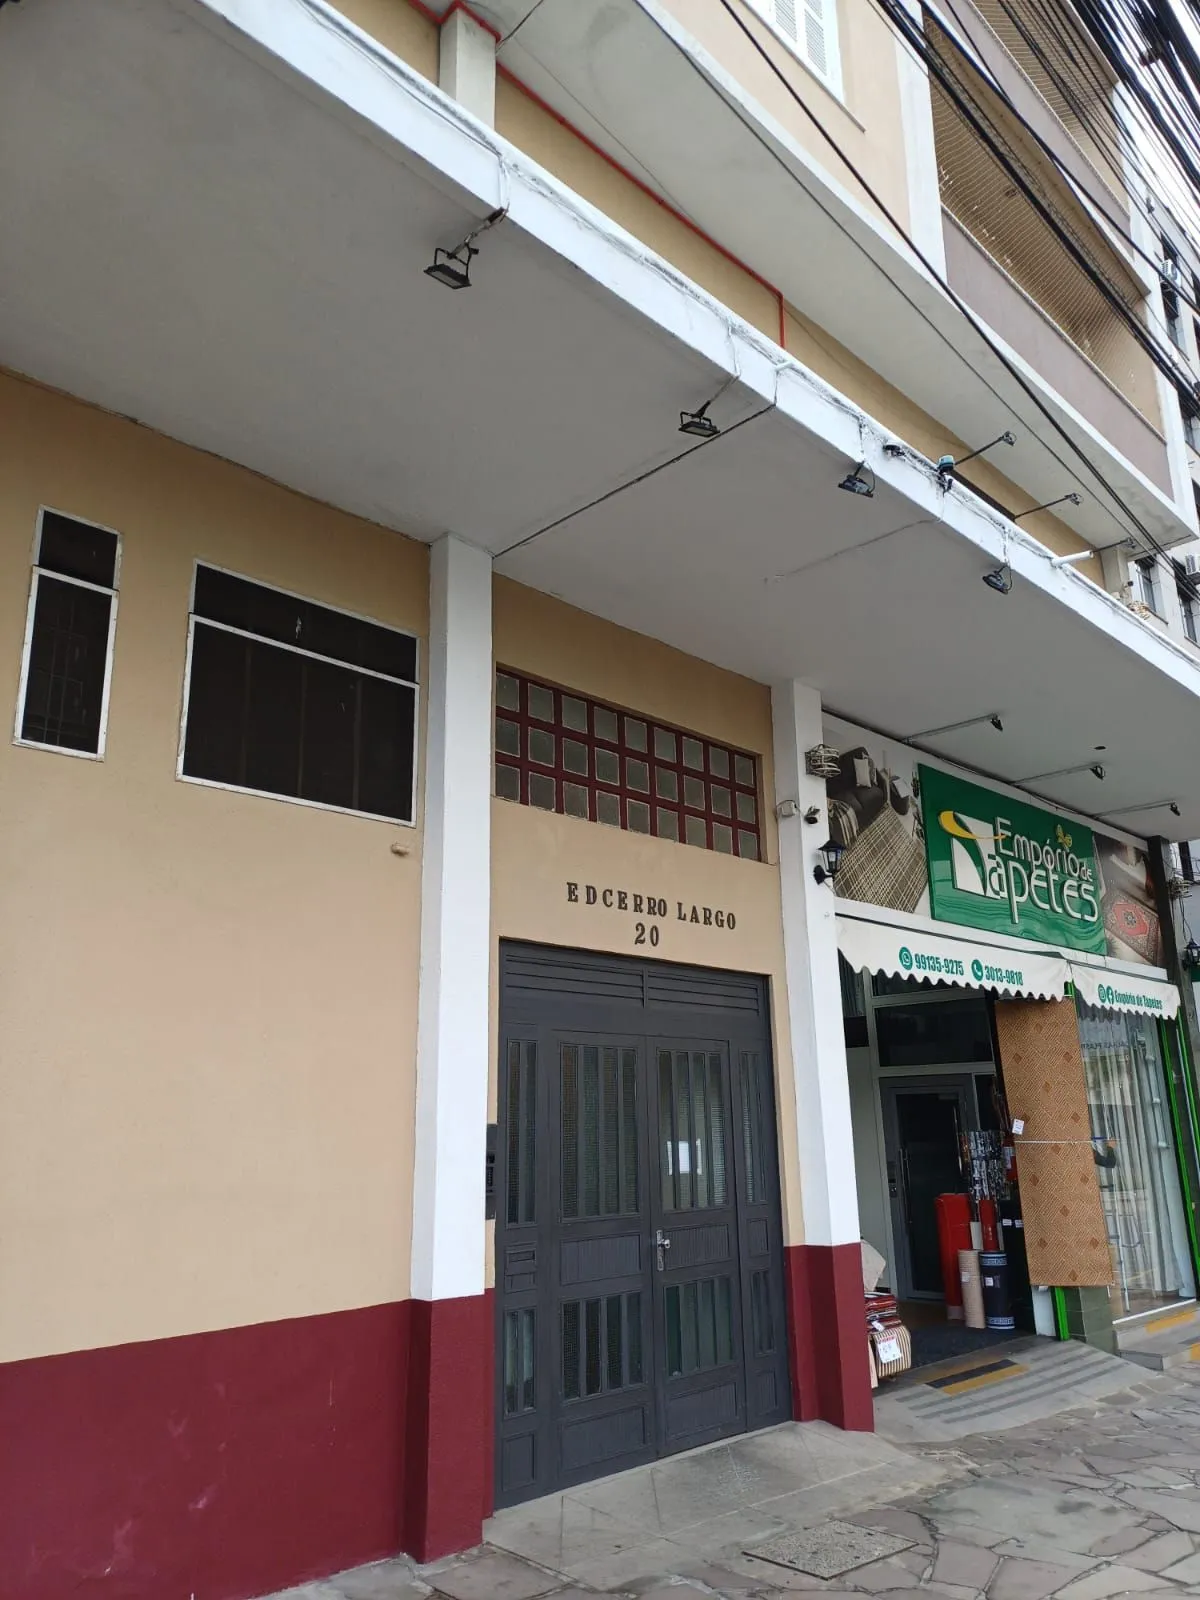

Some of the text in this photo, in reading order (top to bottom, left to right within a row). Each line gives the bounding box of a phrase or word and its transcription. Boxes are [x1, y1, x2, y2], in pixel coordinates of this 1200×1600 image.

[994, 817, 1093, 882] Empório de
[676, 901, 737, 930] LARGO
[634, 922, 660, 947] 20
[914, 953, 964, 976] 99135-9275
